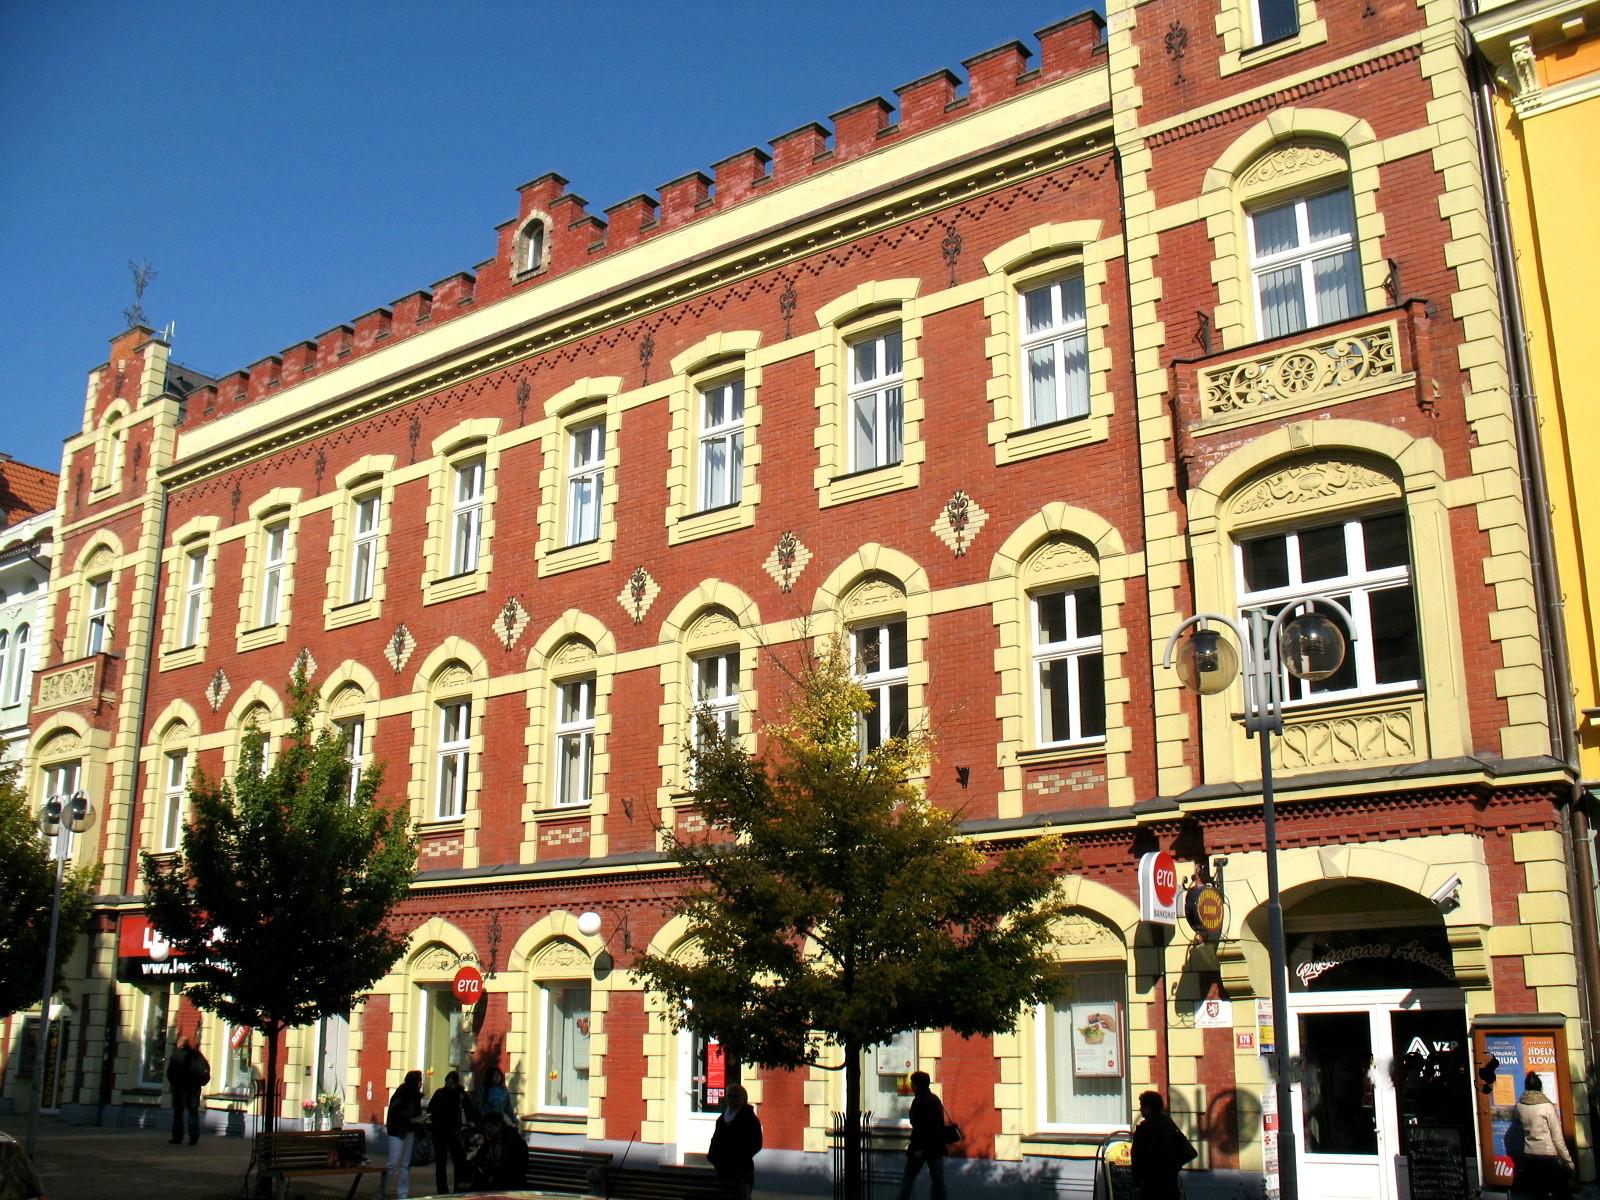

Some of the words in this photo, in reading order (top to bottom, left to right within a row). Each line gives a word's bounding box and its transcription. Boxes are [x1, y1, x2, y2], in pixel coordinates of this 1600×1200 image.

[1156, 868, 1174, 888] era
[1153, 909, 1176, 920] BANKOMAT
[1295, 943, 1392, 987] Restaurace
[457, 979, 479, 993] era
[1432, 1040, 1459, 1052] VZP
[1528, 1046, 1556, 1056] JÍDELN
[1528, 1056, 1556, 1065] SLOVA
